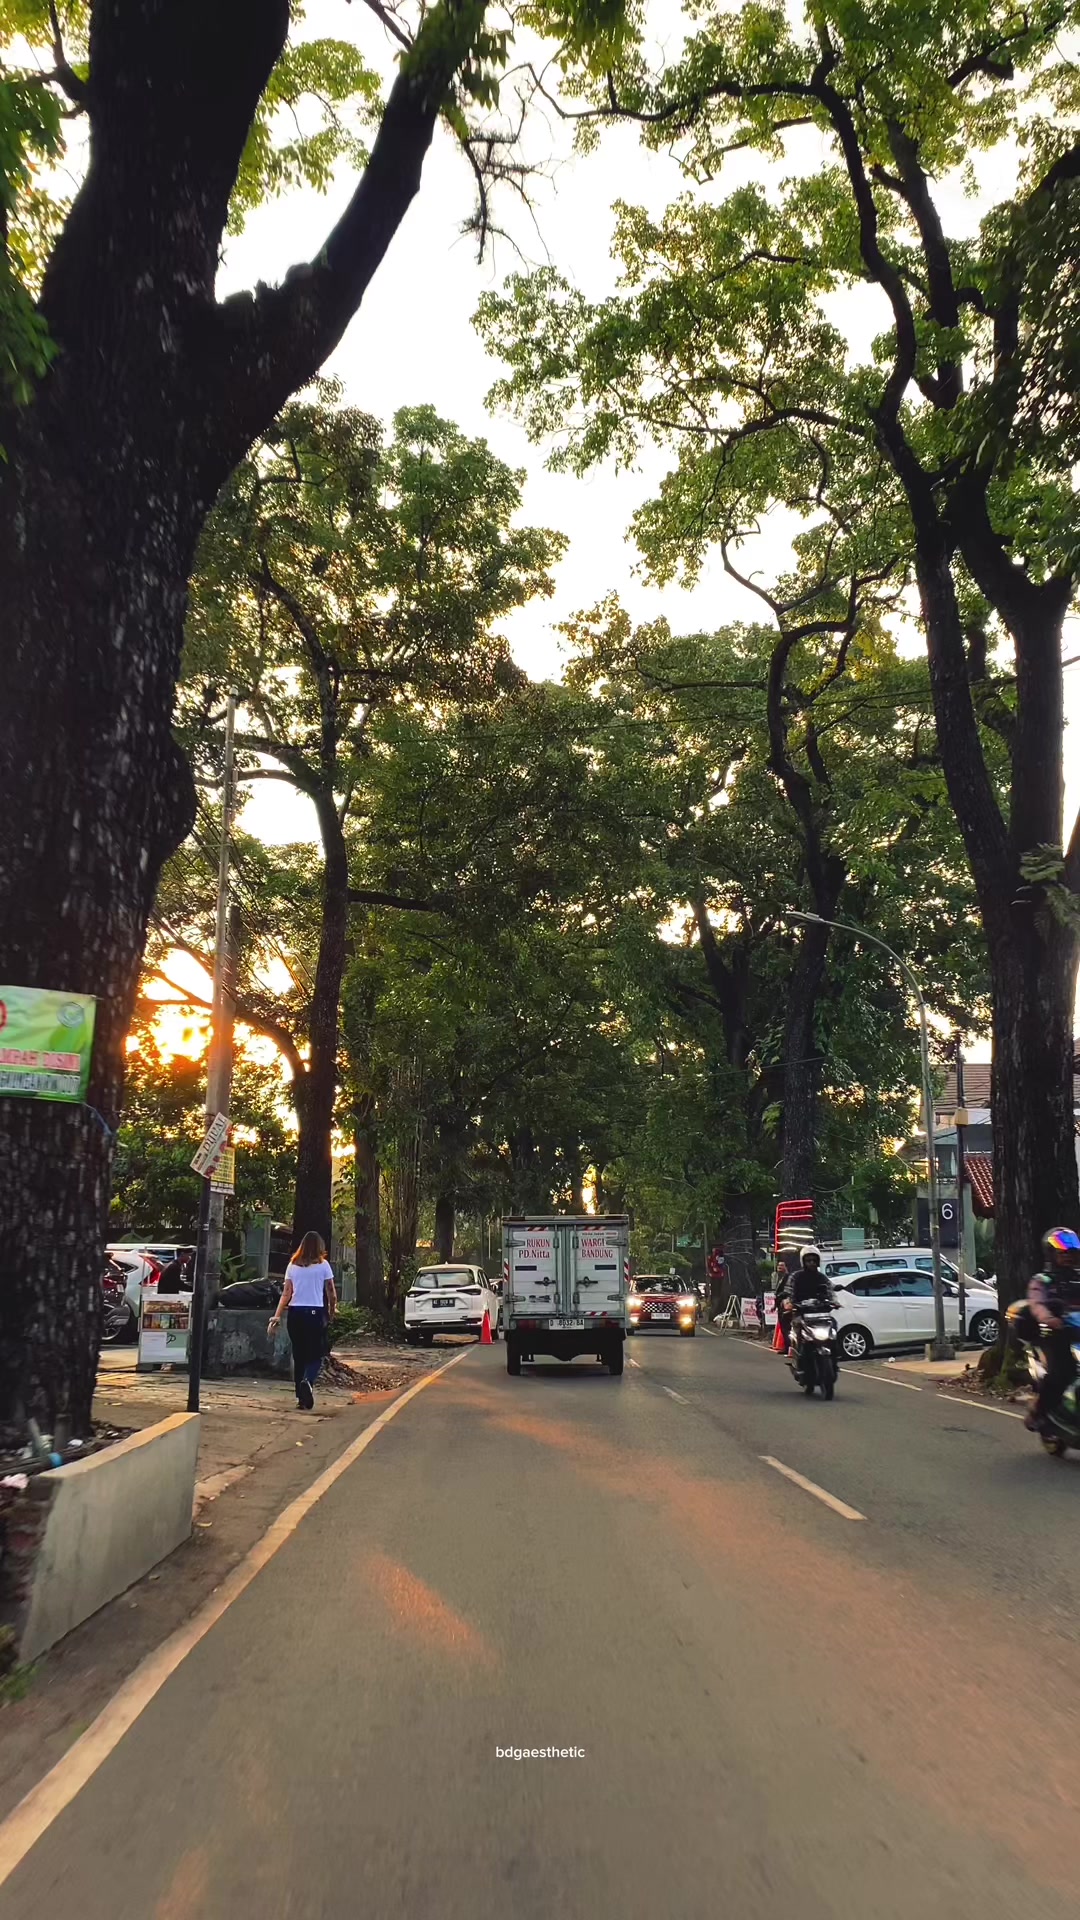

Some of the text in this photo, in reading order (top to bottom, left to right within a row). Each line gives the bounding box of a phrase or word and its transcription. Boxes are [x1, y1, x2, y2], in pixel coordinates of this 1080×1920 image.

[203, 1117, 226, 1152] DIJUAL
[941, 1202, 953, 1220] 6
[526, 1238, 550, 1248] RUKUN
[518, 1249, 613, 1259] PD.Nitta BANDUNG
